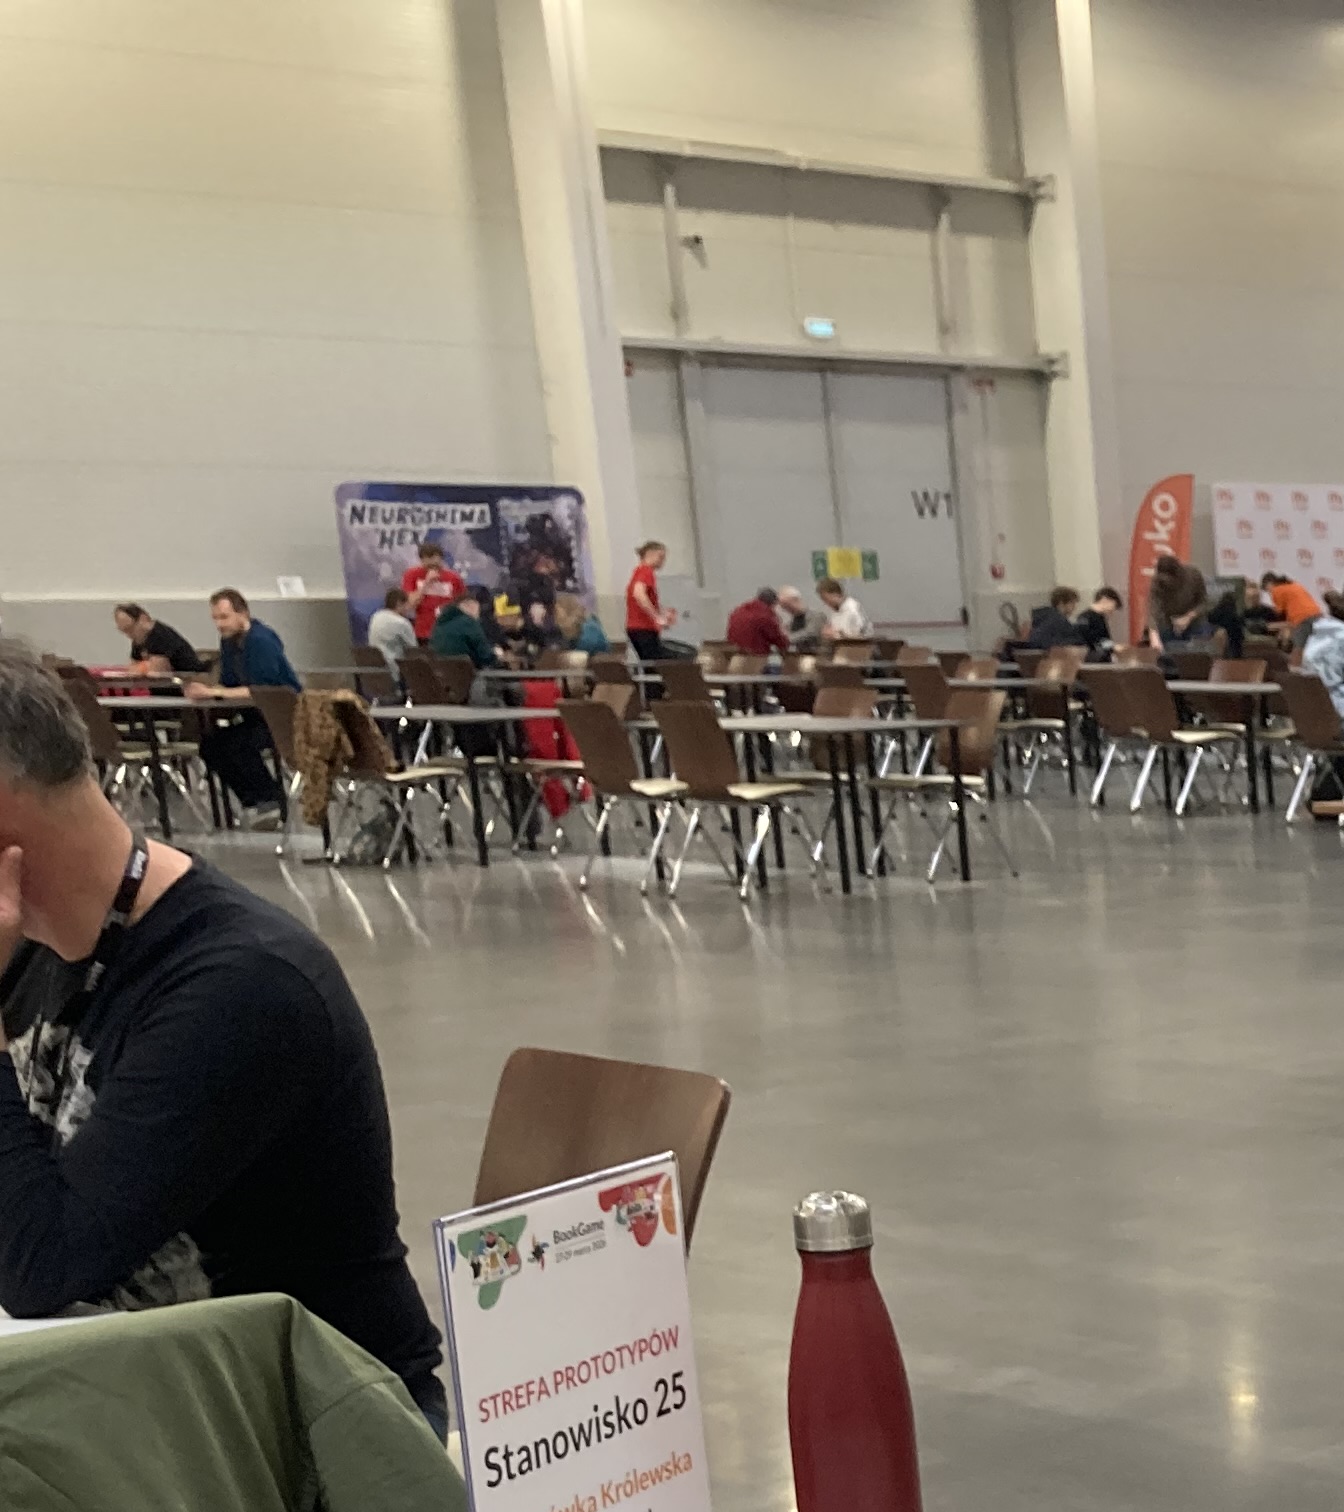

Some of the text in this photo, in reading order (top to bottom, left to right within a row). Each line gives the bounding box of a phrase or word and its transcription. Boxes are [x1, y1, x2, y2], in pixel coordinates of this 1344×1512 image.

[349, 503, 489, 526] NEUROSHIMA
[478, 1324, 680, 1424] STREFA PROTOTYPÓW
[483, 1369, 687, 1489] Stanowisko 25
[600, 1450, 694, 1508] Królewska
